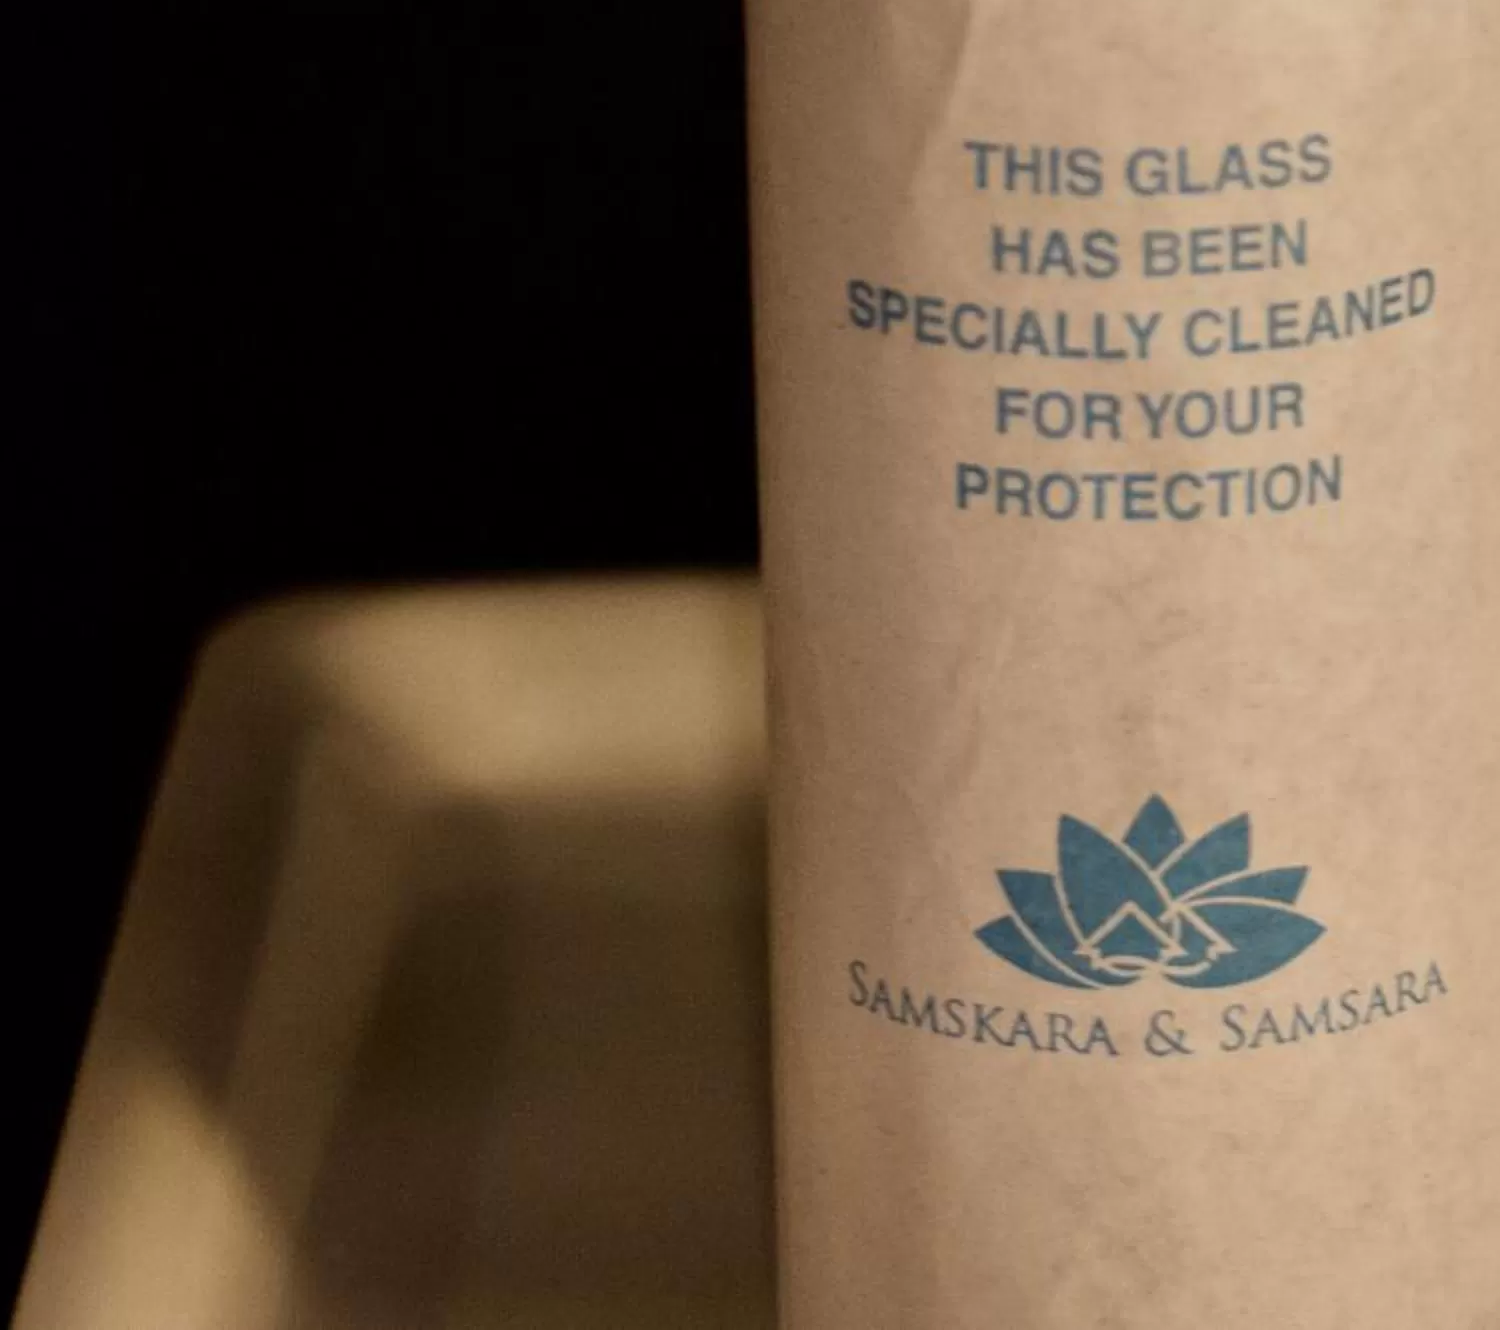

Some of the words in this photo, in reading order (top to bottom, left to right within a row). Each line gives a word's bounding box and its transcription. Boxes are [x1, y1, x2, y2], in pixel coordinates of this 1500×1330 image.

[964, 139, 1104, 197] THIS
[1125, 133, 1333, 197] GLASS
[991, 225, 1120, 279] HAS
[1143, 220, 1309, 278] BEEN
[847, 279, 1162, 360] SPECIALLY
[1184, 268, 1437, 357] CLEANED
[995, 387, 1121, 440] FOR
[1134, 381, 1304, 439] YOUR
[955, 455, 1342, 521] PROTECTION
[849, 960, 1119, 1057] SAMSKARA
[1144, 1009, 1195, 1057] &
[1219, 961, 1450, 1052] SAMSARA
